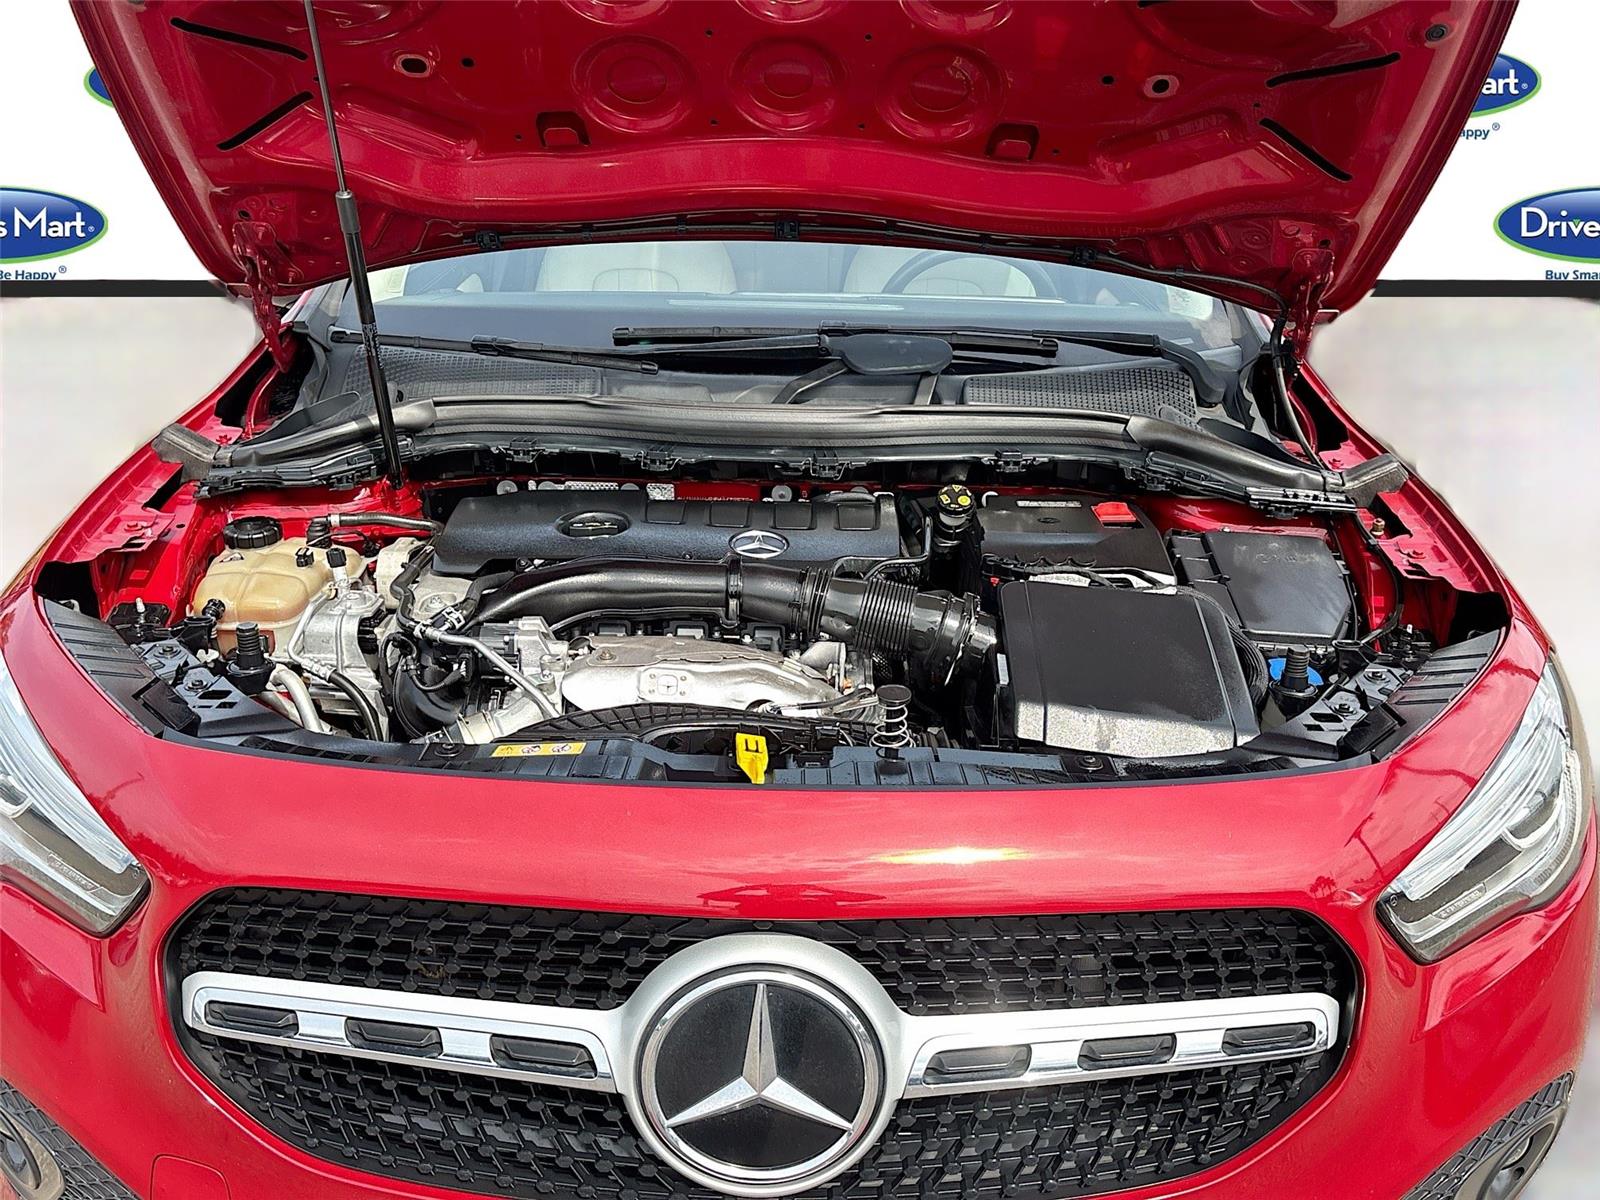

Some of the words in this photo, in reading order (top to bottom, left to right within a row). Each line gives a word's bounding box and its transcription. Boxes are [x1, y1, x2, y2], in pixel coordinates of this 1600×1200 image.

[1481, 69, 1519, 95] art
[1460, 128, 1490, 140] appy
[14, 206, 86, 238] Mart
[1521, 207, 1600, 238] Drive
